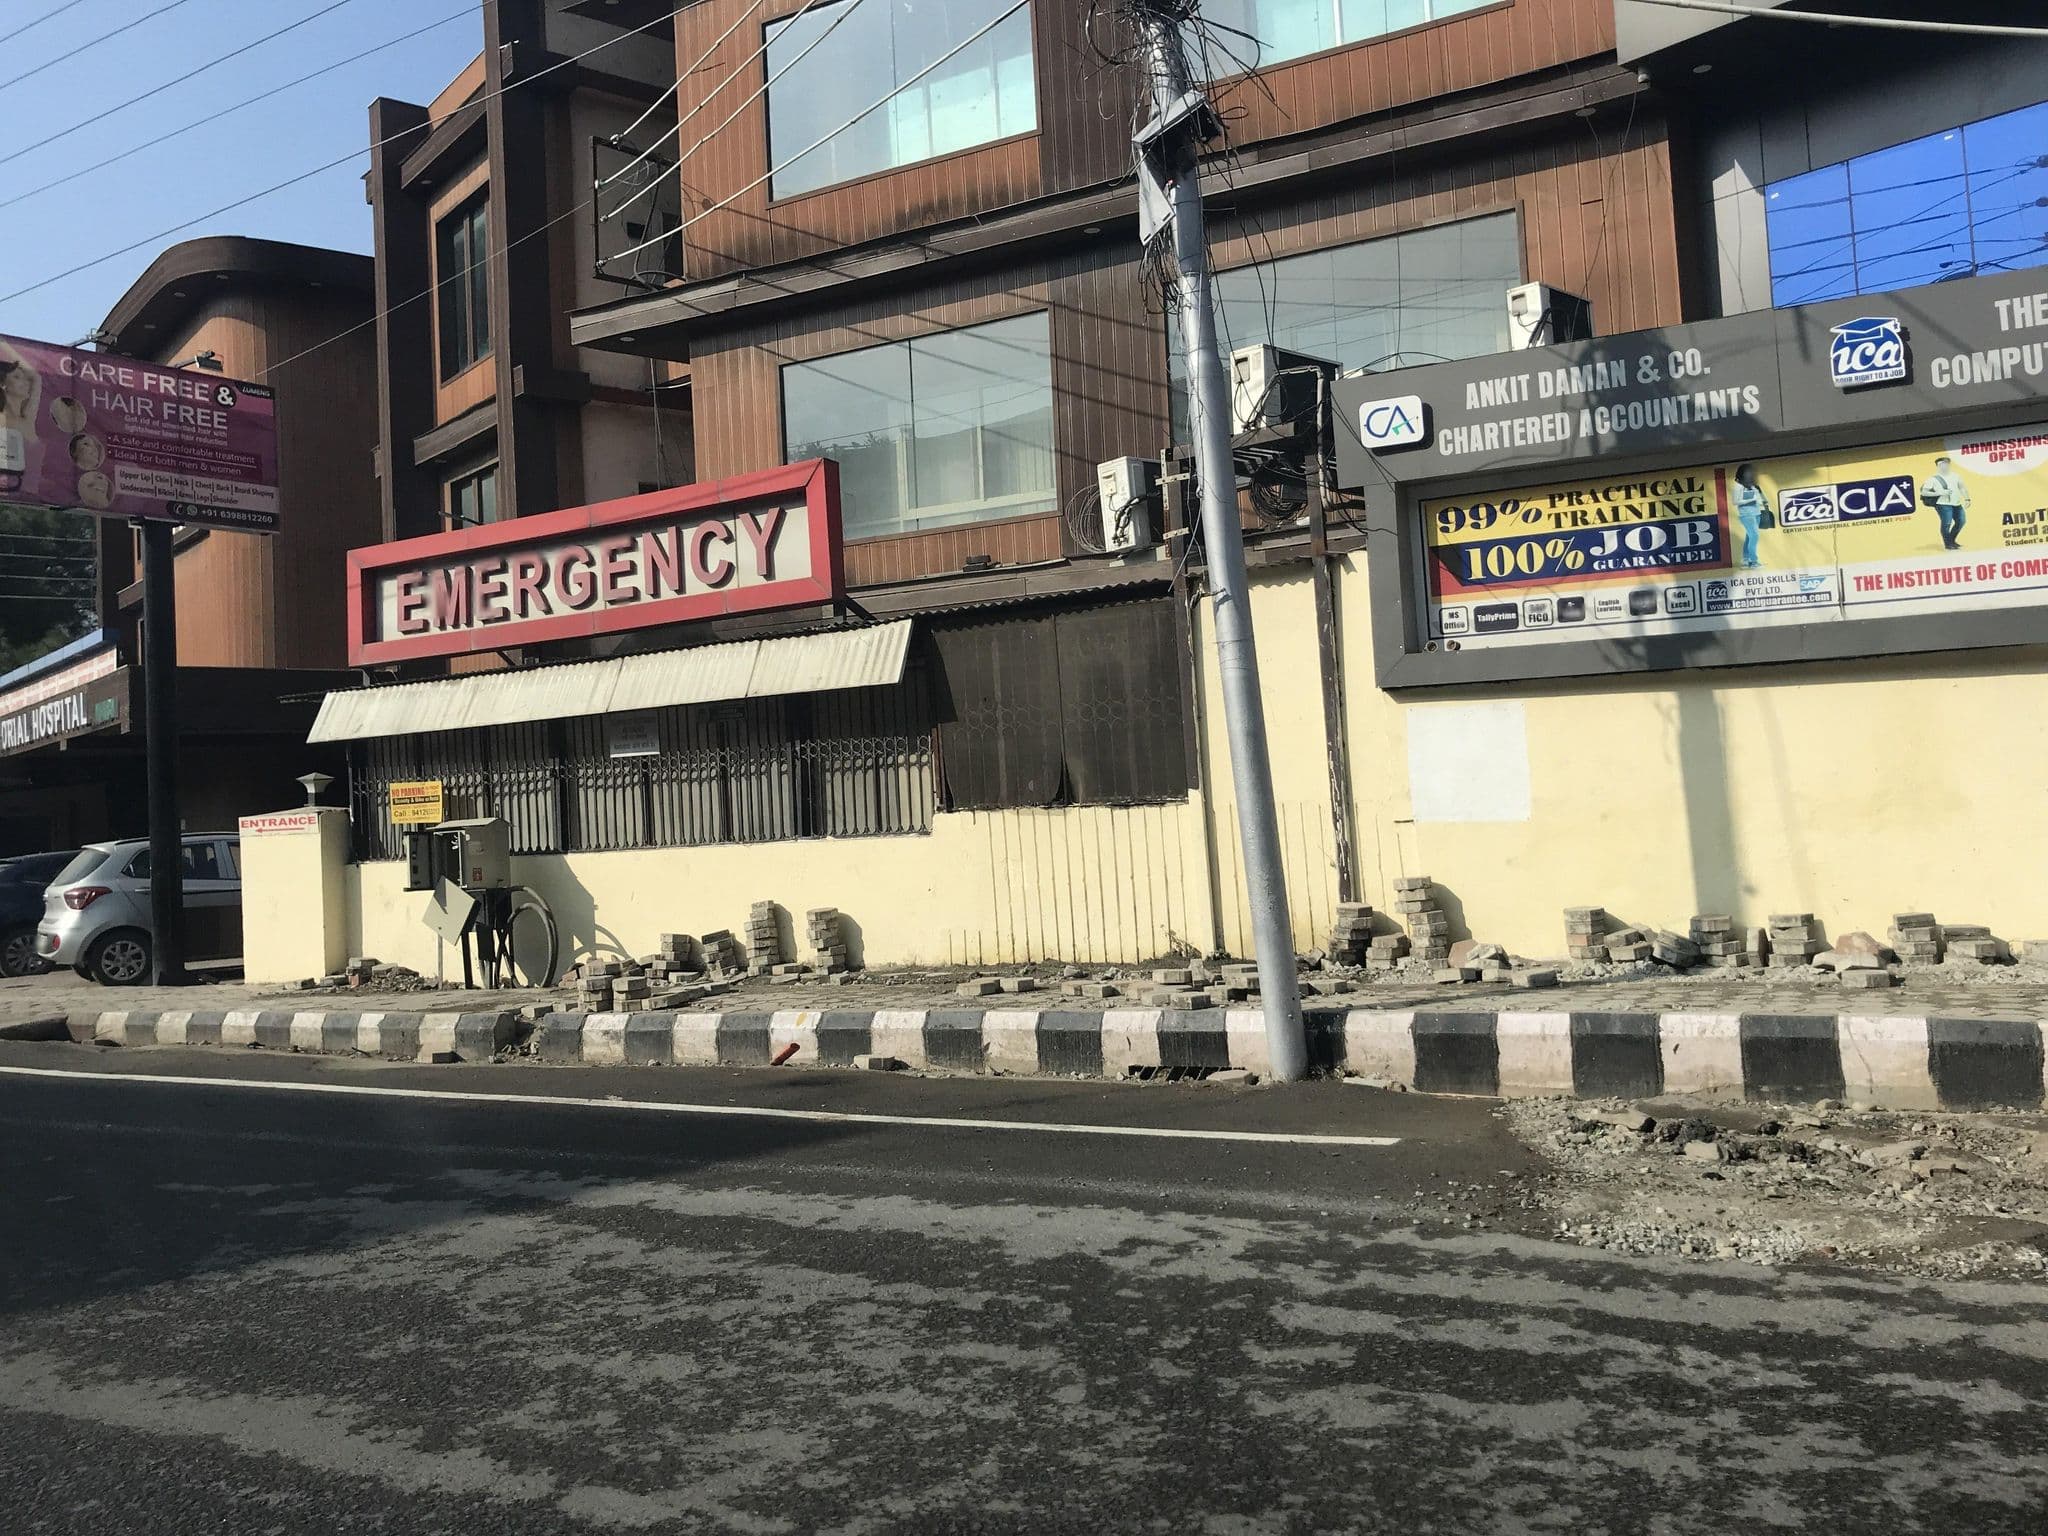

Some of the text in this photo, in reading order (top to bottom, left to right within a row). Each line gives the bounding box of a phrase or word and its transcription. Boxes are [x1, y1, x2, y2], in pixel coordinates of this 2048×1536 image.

[1994, 293, 2048, 331] THE
[1833, 340, 1901, 374] ica
[60, 356, 234, 406] CARE FREE &
[1466, 347, 1711, 410] ANKIT DAMAN & CO.
[92, 389, 155, 418] HAIR
[163, 402, 228, 430] FREE
[1364, 404, 1416, 439] CA
[1438, 385, 1760, 456] CHARTERED ACCOUNTANTS
[122, 435, 141, 445] safe
[143, 440, 160, 449] and
[162, 442, 214, 458] comfortable
[216, 452, 256, 464] treatment
[1961, 434, 2048, 455] ADMISSIONS
[1988, 449, 2025, 463] OPEN
[155, 456, 177, 466] both
[178, 460, 198, 469] men
[210, 466, 241, 476] women
[1438, 477, 1704, 533] 99% PRACTICAL
[1547, 496, 1707, 529] TRAINING
[2002, 508, 2048, 525] AnyT
[2002, 524, 2039, 538] card
[1465, 520, 1713, 580] 100% JOB
[1593, 550, 1713, 571] GUARANTEE
[396, 507, 785, 634] EMERGENCY
[1730, 574, 1797, 587] ICA EDU SKILLS
[1853, 574, 1883, 592] THE
[1887, 566, 1972, 589] INSTITUTE
[1976, 563, 1996, 581] OF
[1448, 611, 1460, 619] MS
[1477, 612, 1517, 622] TallyPrime
[1528, 613, 1549, 623] FICO
[32, 692, 88, 740] HOSPITAL
[241, 815, 317, 829] ENTRANCE
